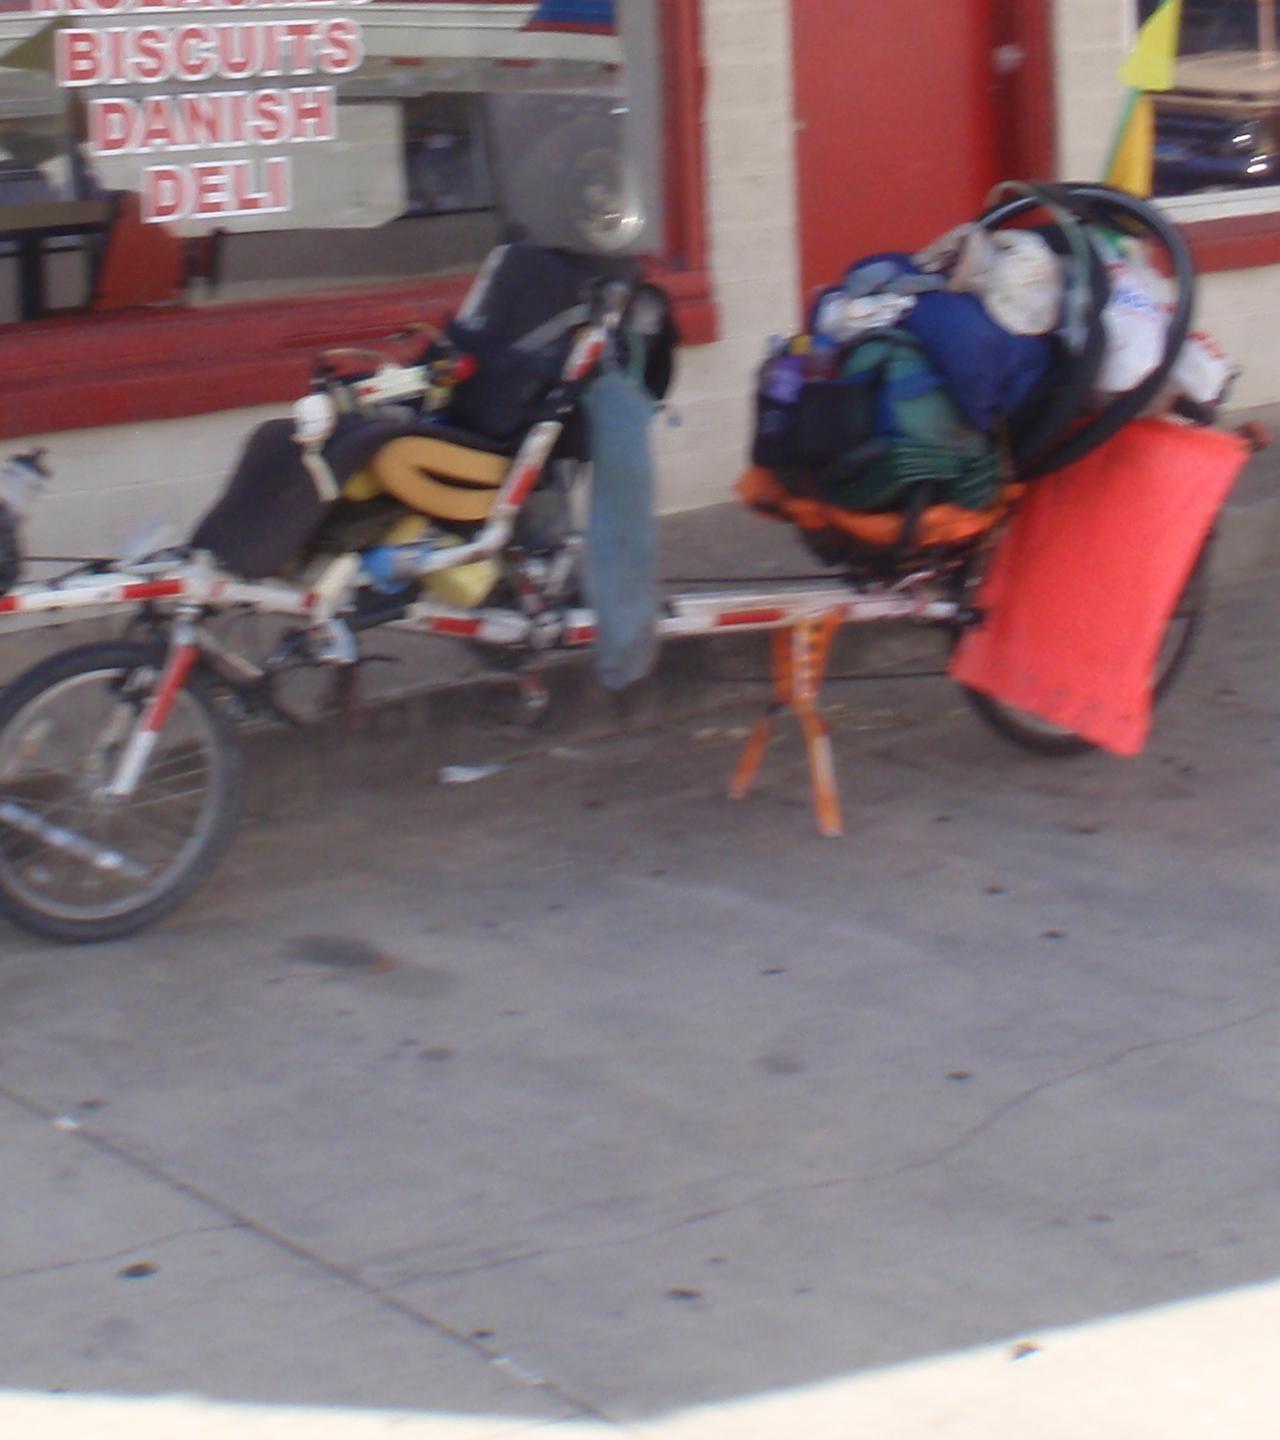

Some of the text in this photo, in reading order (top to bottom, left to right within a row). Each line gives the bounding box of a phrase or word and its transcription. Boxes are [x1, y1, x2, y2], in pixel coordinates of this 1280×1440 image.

[55, 19, 363, 87] BISCUITS
[88, 85, 337, 156] DANISH
[142, 157, 292, 224] DELI
